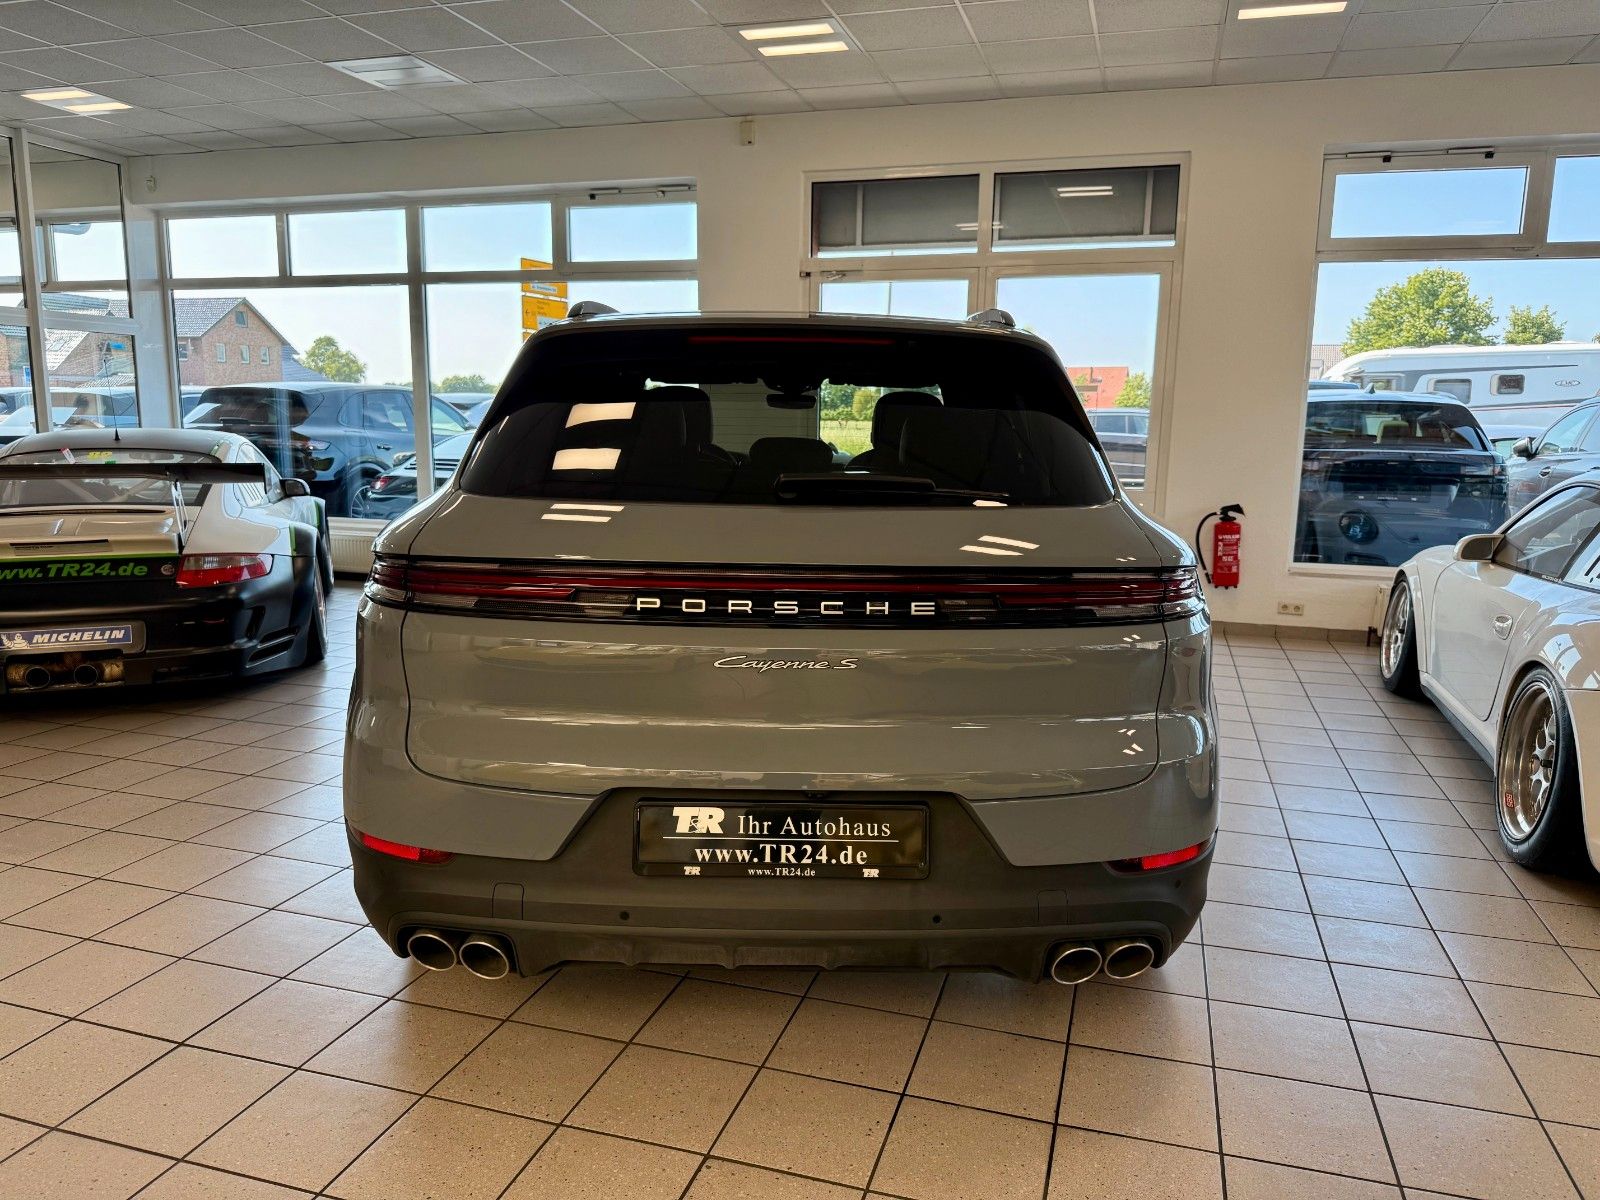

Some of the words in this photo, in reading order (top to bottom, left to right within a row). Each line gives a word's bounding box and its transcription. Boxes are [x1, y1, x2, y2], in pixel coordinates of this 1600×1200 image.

[636, 598, 936, 615] PORSCHE
[32, 629, 125, 644] MICHELIN
[713, 655, 830, 673] Cayenne
[833, 658, 859, 669] S
[737, 815, 772, 835] Ihr
[780, 816, 891, 837] Autohaus
[694, 843, 868, 865] www.TR24.de
[748, 867, 816, 877] www.TR24.de
